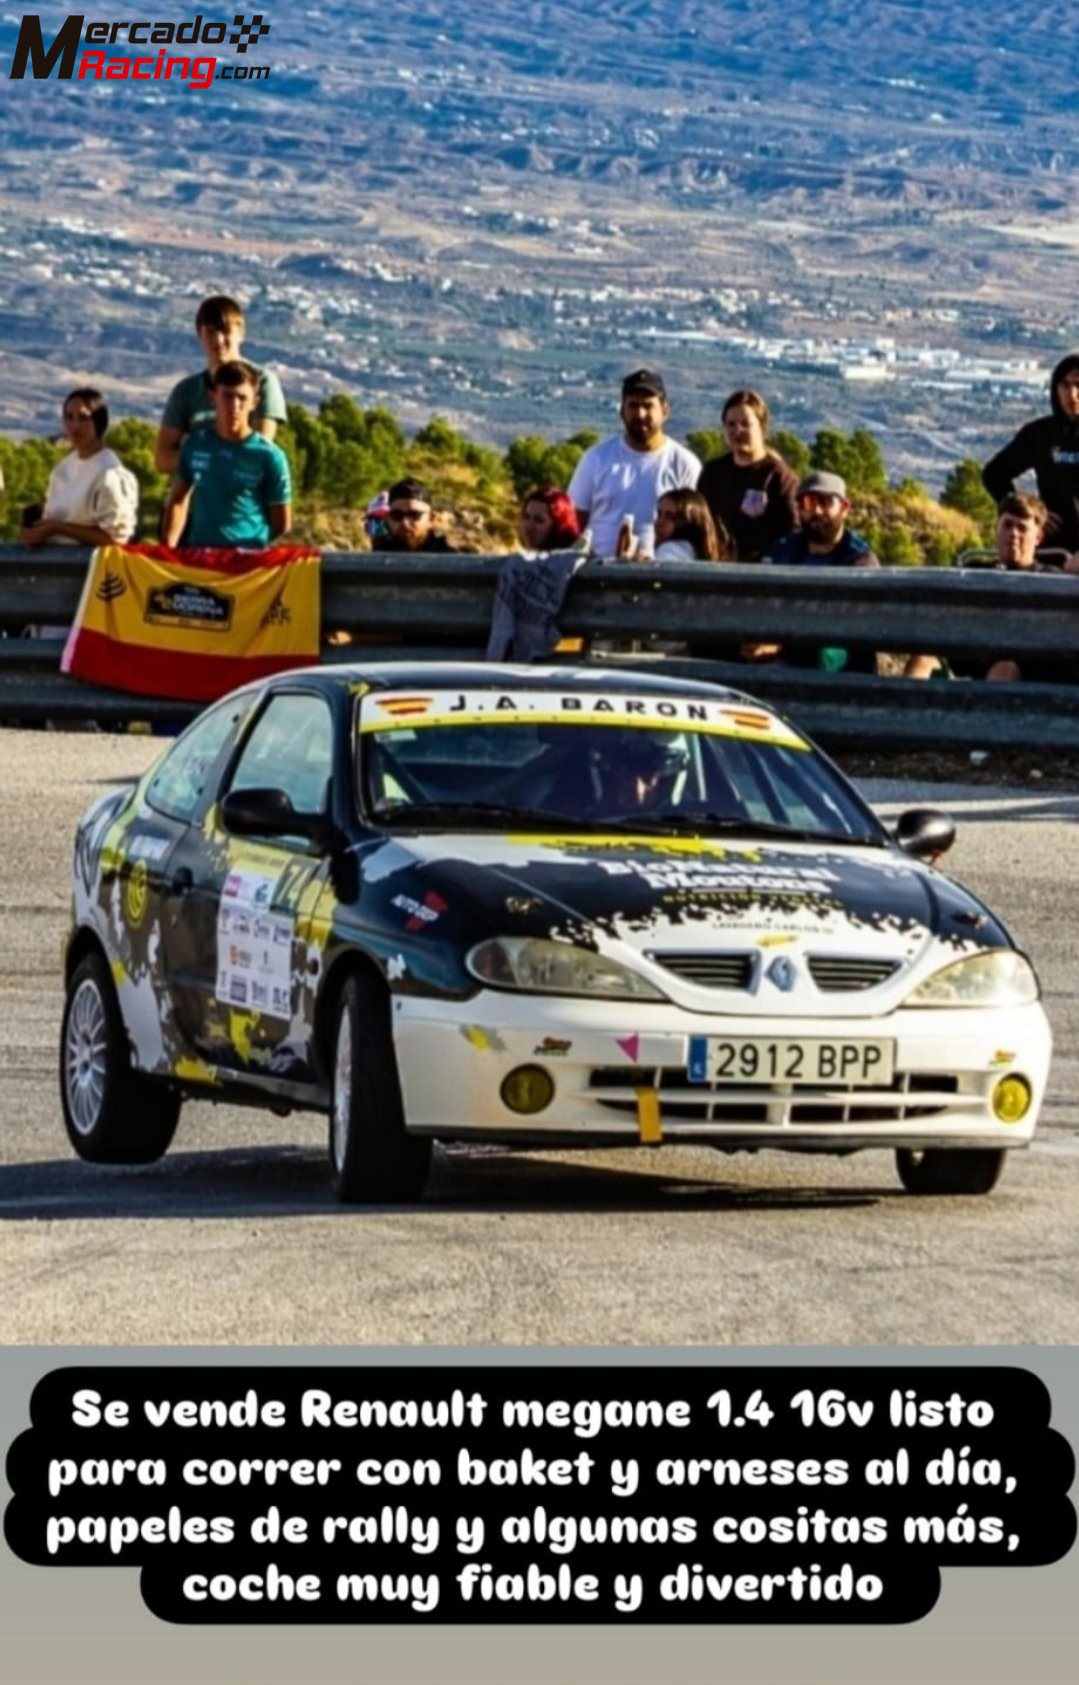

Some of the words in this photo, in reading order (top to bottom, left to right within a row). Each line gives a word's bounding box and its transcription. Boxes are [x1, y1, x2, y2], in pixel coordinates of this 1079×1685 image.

[561, 697, 708, 721] BARON
[716, 1043, 804, 1078] 2912
[818, 1044, 881, 1079] BPP
